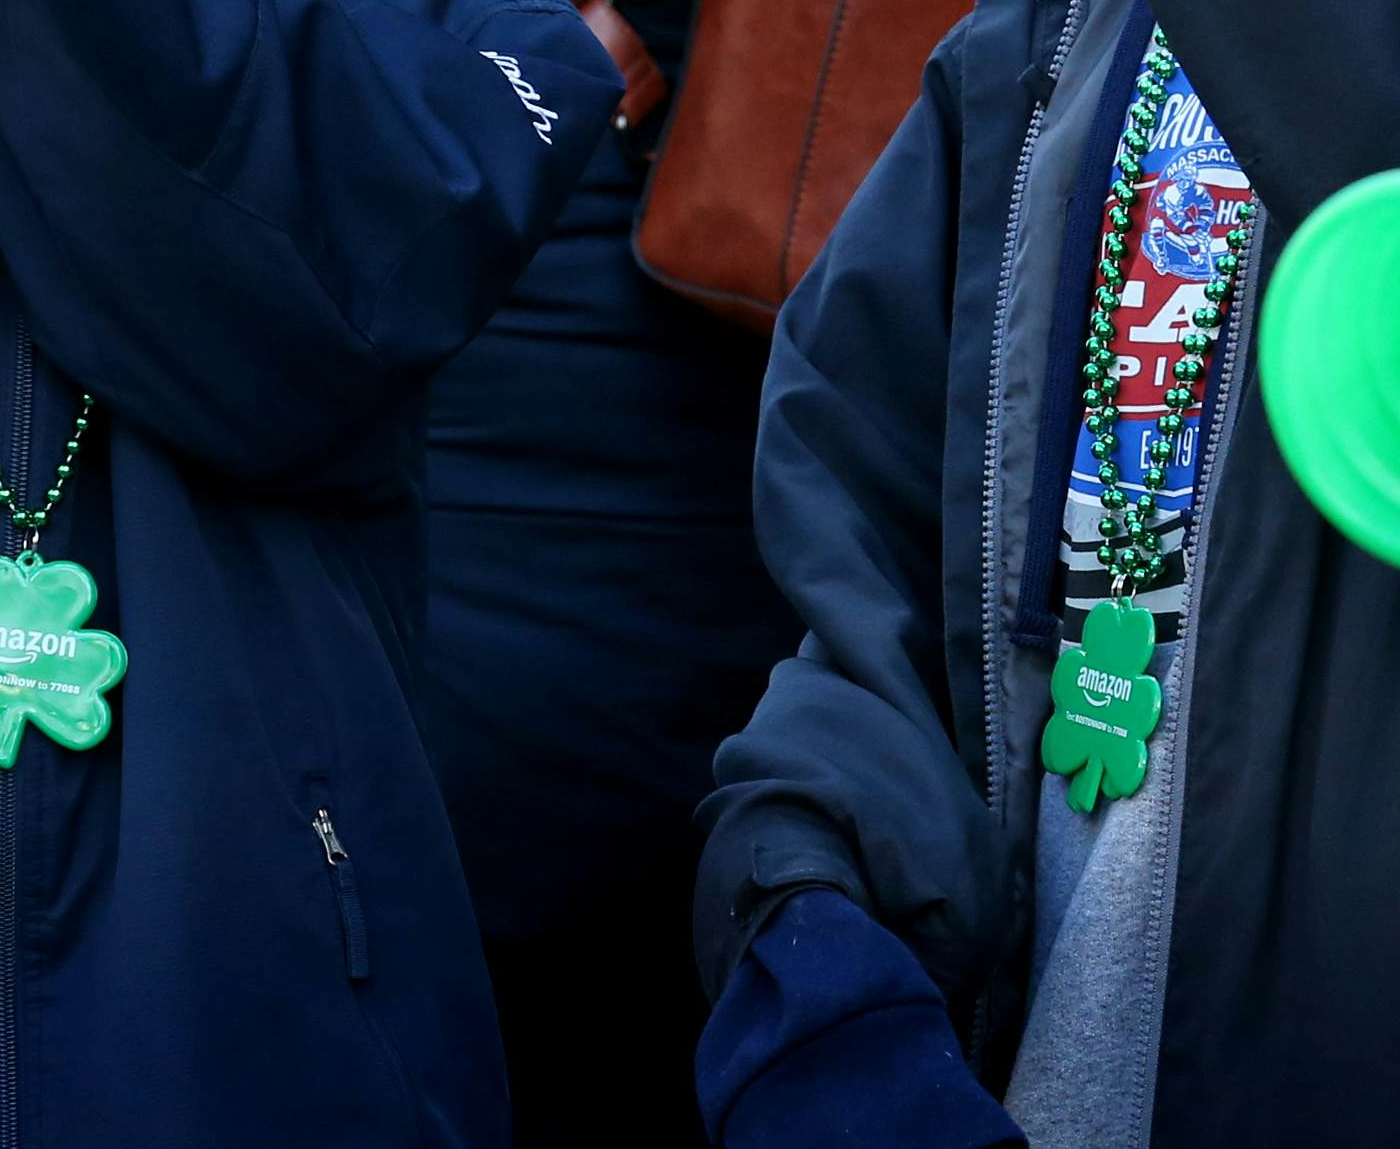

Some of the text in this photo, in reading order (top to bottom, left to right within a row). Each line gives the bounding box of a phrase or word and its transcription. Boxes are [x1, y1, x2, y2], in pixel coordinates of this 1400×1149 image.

[1175, 426, 1200, 468] 19
[38, 681, 48, 690] to
[50, 682, 81, 695] 77088
[1077, 666, 1132, 701] amazon
